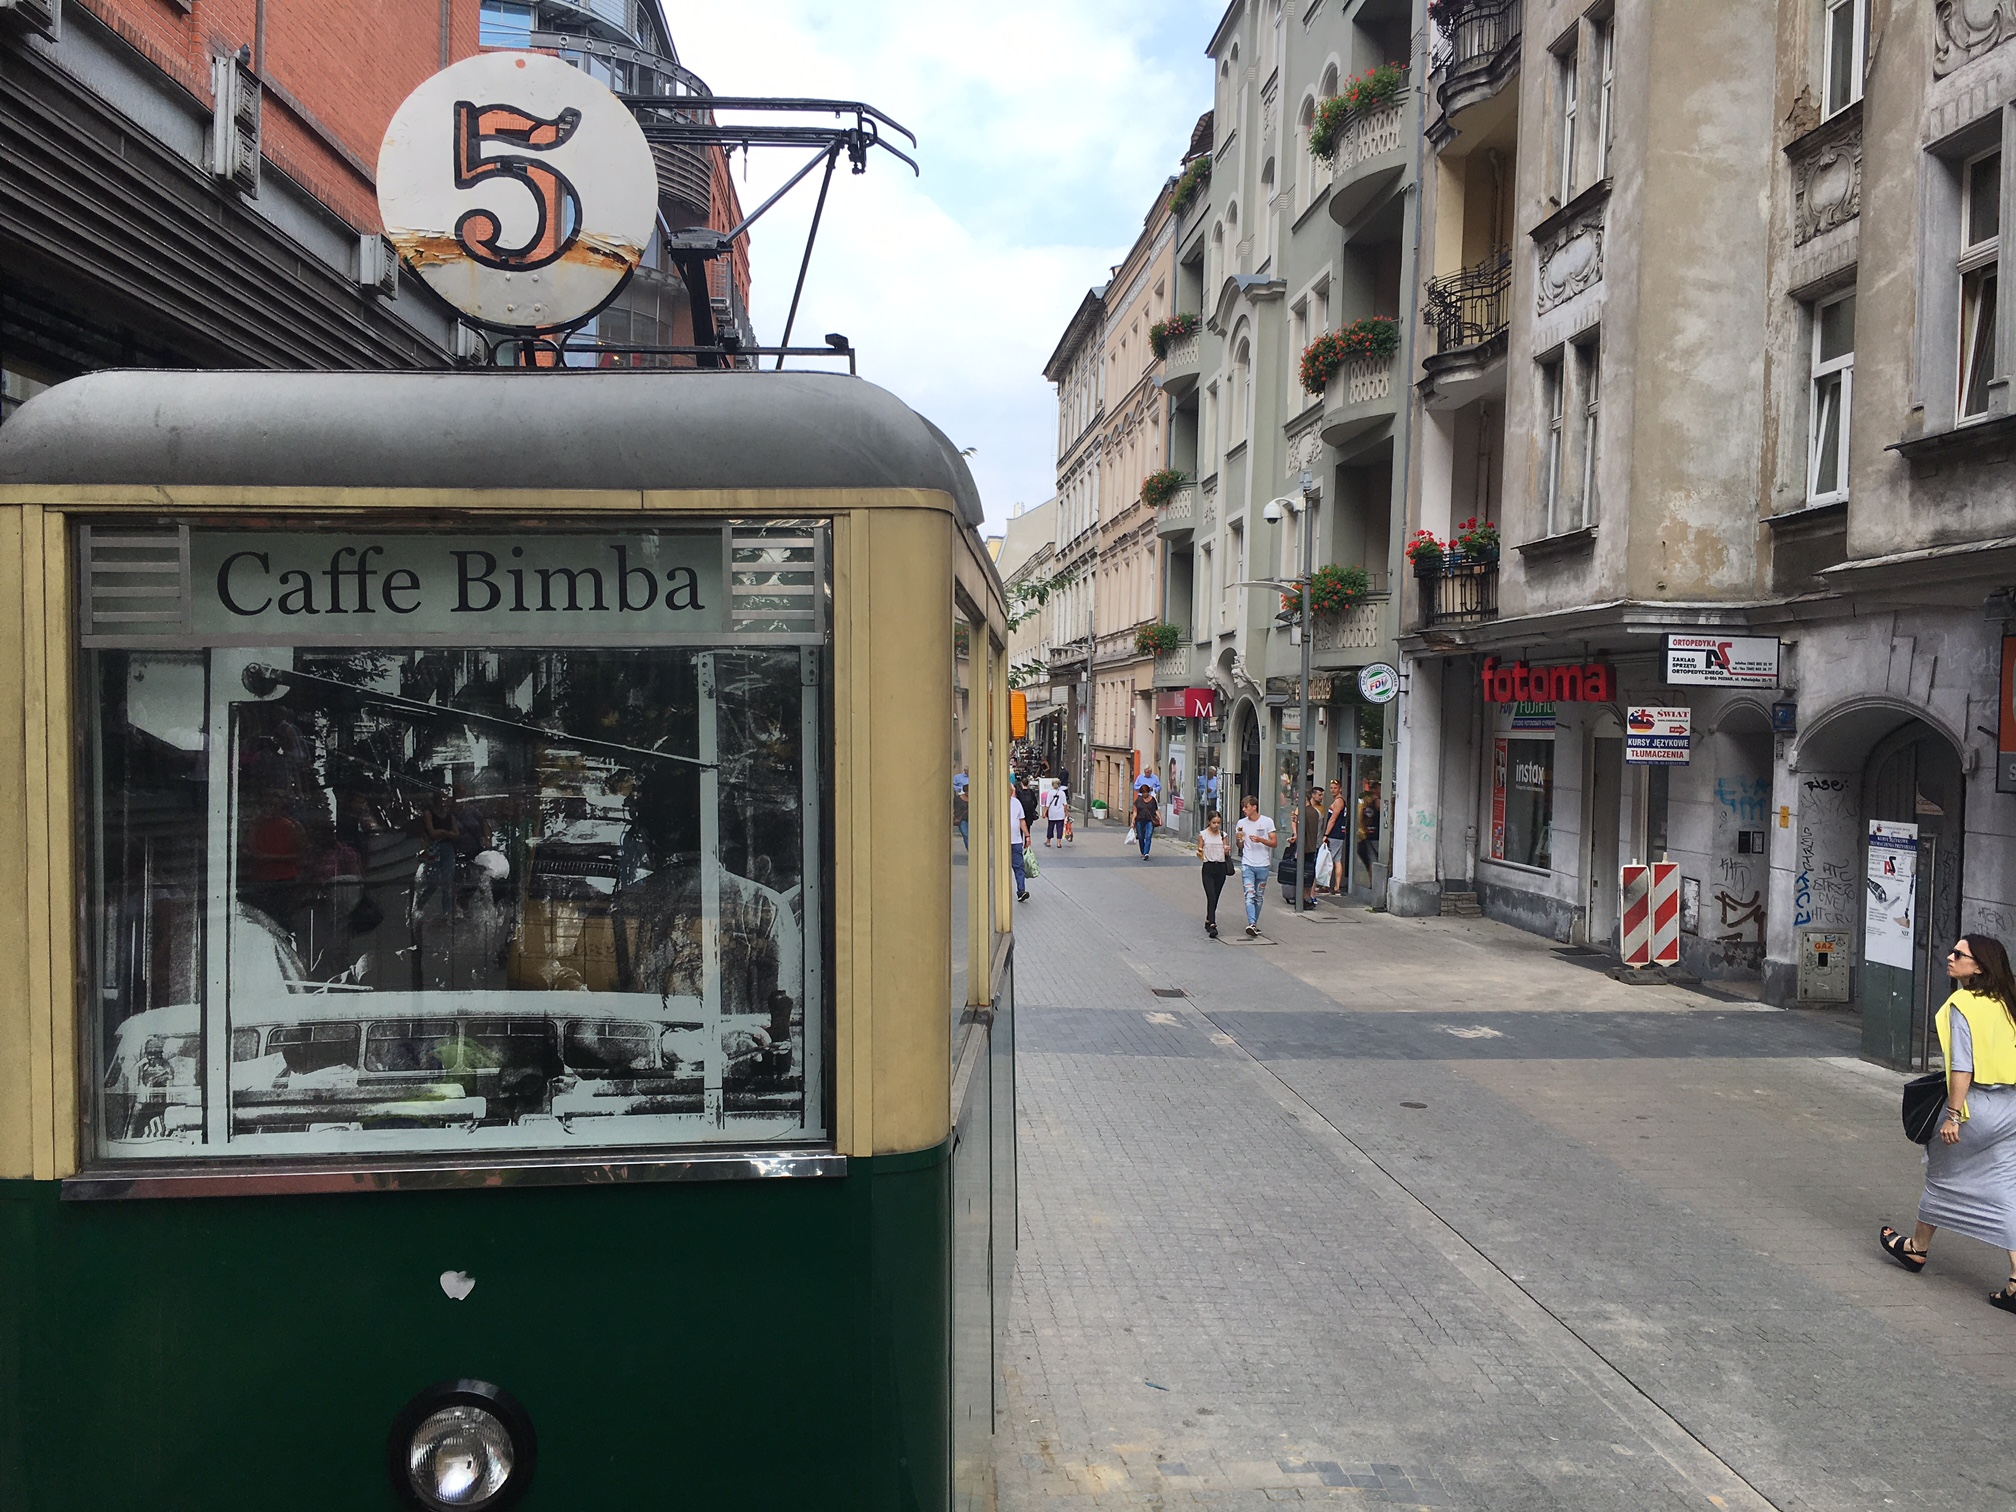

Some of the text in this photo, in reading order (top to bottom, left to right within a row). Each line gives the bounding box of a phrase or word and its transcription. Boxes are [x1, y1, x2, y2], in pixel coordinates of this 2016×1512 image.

[453, 100, 582, 272] 5
[216, 545, 706, 616] Caffe Bimba
[1672, 638, 1716, 647] ORTOPEDYKA
[1481, 656, 1611, 702] fotoma
[1194, 698, 1213, 717] M
[1657, 709, 1689, 718] ŚWIAT
[1628, 738, 1689, 748] KURSY JĘZYKOWE
[1631, 750, 1684, 759] TŁUMACZENIA
[1515, 759, 1544, 785] instax
[1053, 795, 1060, 806] 7
